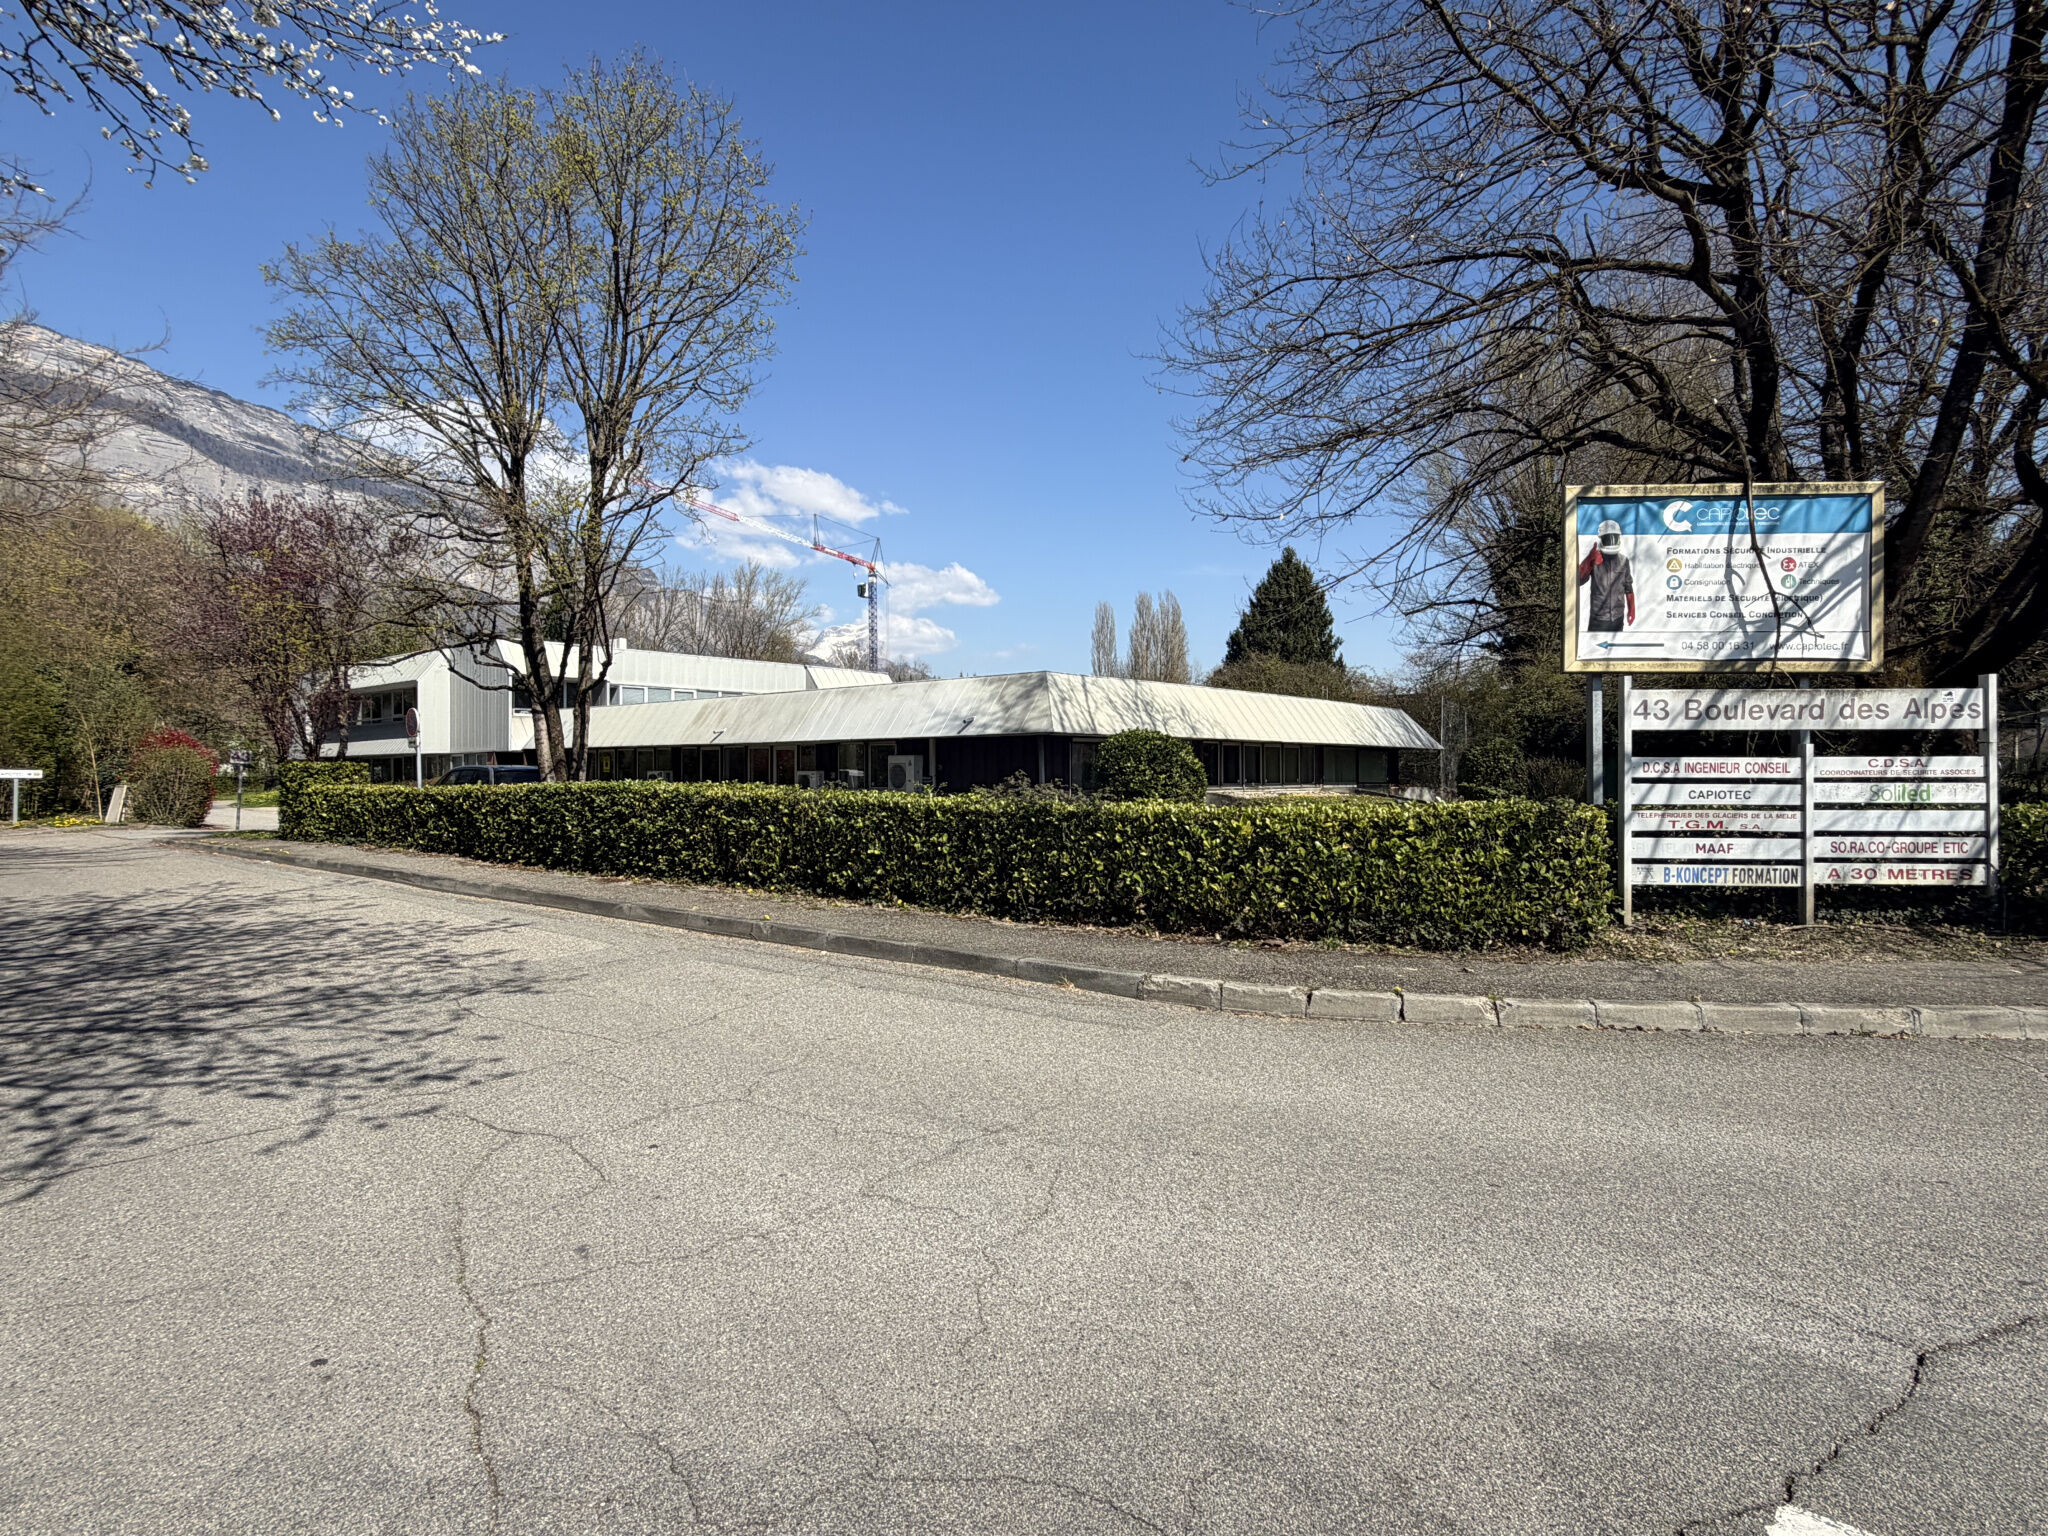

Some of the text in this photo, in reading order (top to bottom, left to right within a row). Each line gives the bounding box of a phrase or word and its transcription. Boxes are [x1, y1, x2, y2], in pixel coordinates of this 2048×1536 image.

[1681, 641, 1693, 650] 04
[1696, 641, 1709, 650] 58
[1743, 641, 1754, 650] 31
[1633, 697, 1983, 724] 43 Boulevard des Alpes
[1642, 761, 1791, 774] D.C.S.A INGENIEUR CONSEIL
[1688, 790, 1752, 800] CAPIOTEC
[1869, 784, 1931, 802] Soliled
[1668, 820, 1729, 830] T.G.M.
[1695, 843, 1735, 854] MAAF
[1943, 841, 1969, 854] ETIC
[1663, 867, 1729, 884] B-KONCEPT
[1732, 867, 1799, 885] FORMATION
[1827, 868, 1974, 881] A 30 METRES
